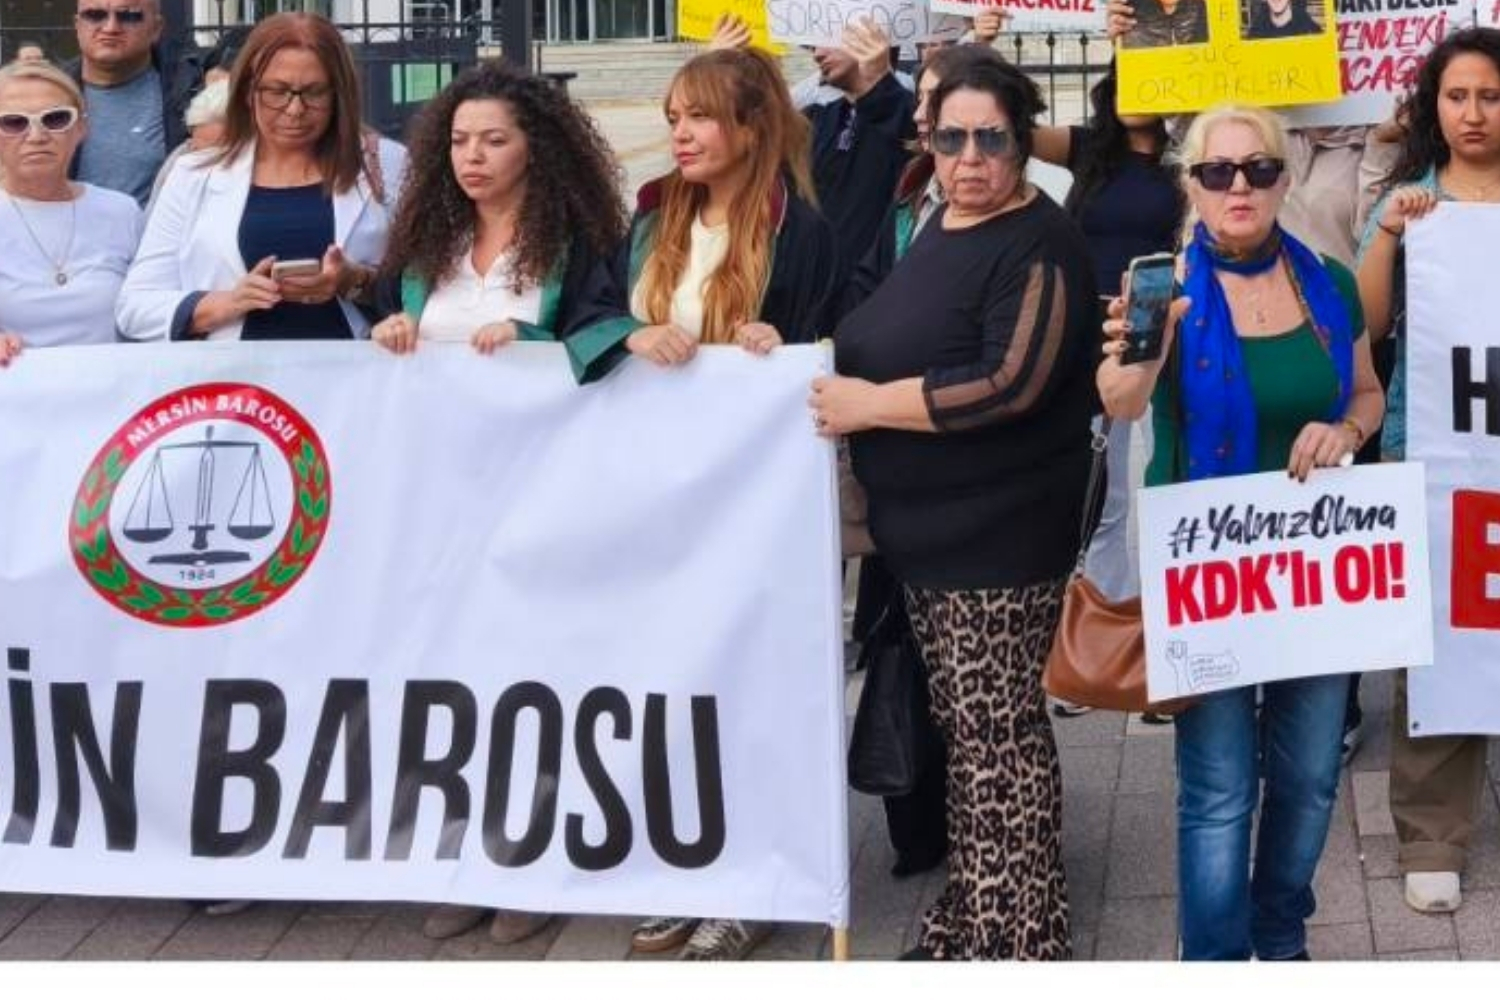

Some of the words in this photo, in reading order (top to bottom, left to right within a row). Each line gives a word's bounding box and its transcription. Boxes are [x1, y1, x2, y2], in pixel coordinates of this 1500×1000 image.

[126, 394, 207, 447] MERSİN
[214, 393, 298, 442] BAROSU
[1167, 493, 1397, 558] #YalnızOlma
[1333, 541, 1407, 605] Ol!
[1, 646, 144, 853] İN
[190, 676, 727, 872] BAROSU
